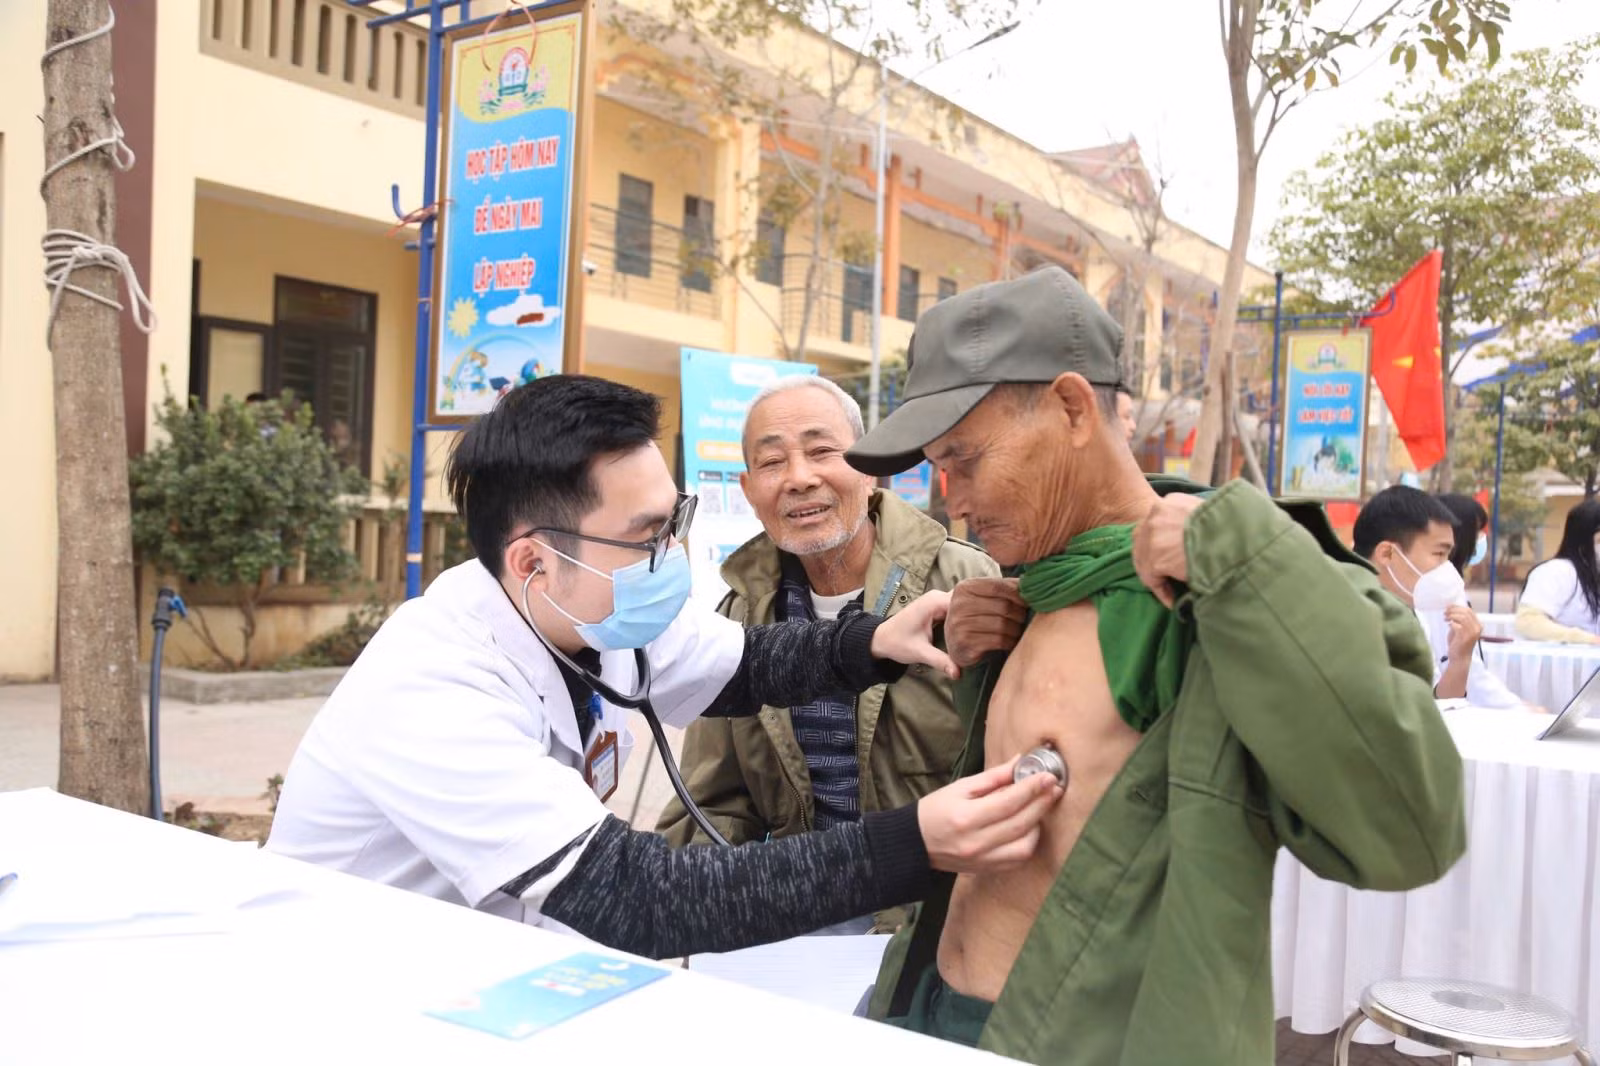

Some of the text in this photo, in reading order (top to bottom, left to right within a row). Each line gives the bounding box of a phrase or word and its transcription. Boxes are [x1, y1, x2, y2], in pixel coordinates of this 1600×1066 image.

[465, 136, 560, 184] HỌC TẬP HÔM NAY
[474, 193, 543, 235] ĐỂ NGÀY MAI
[473, 253, 536, 298] LẬP NGHIỆP
